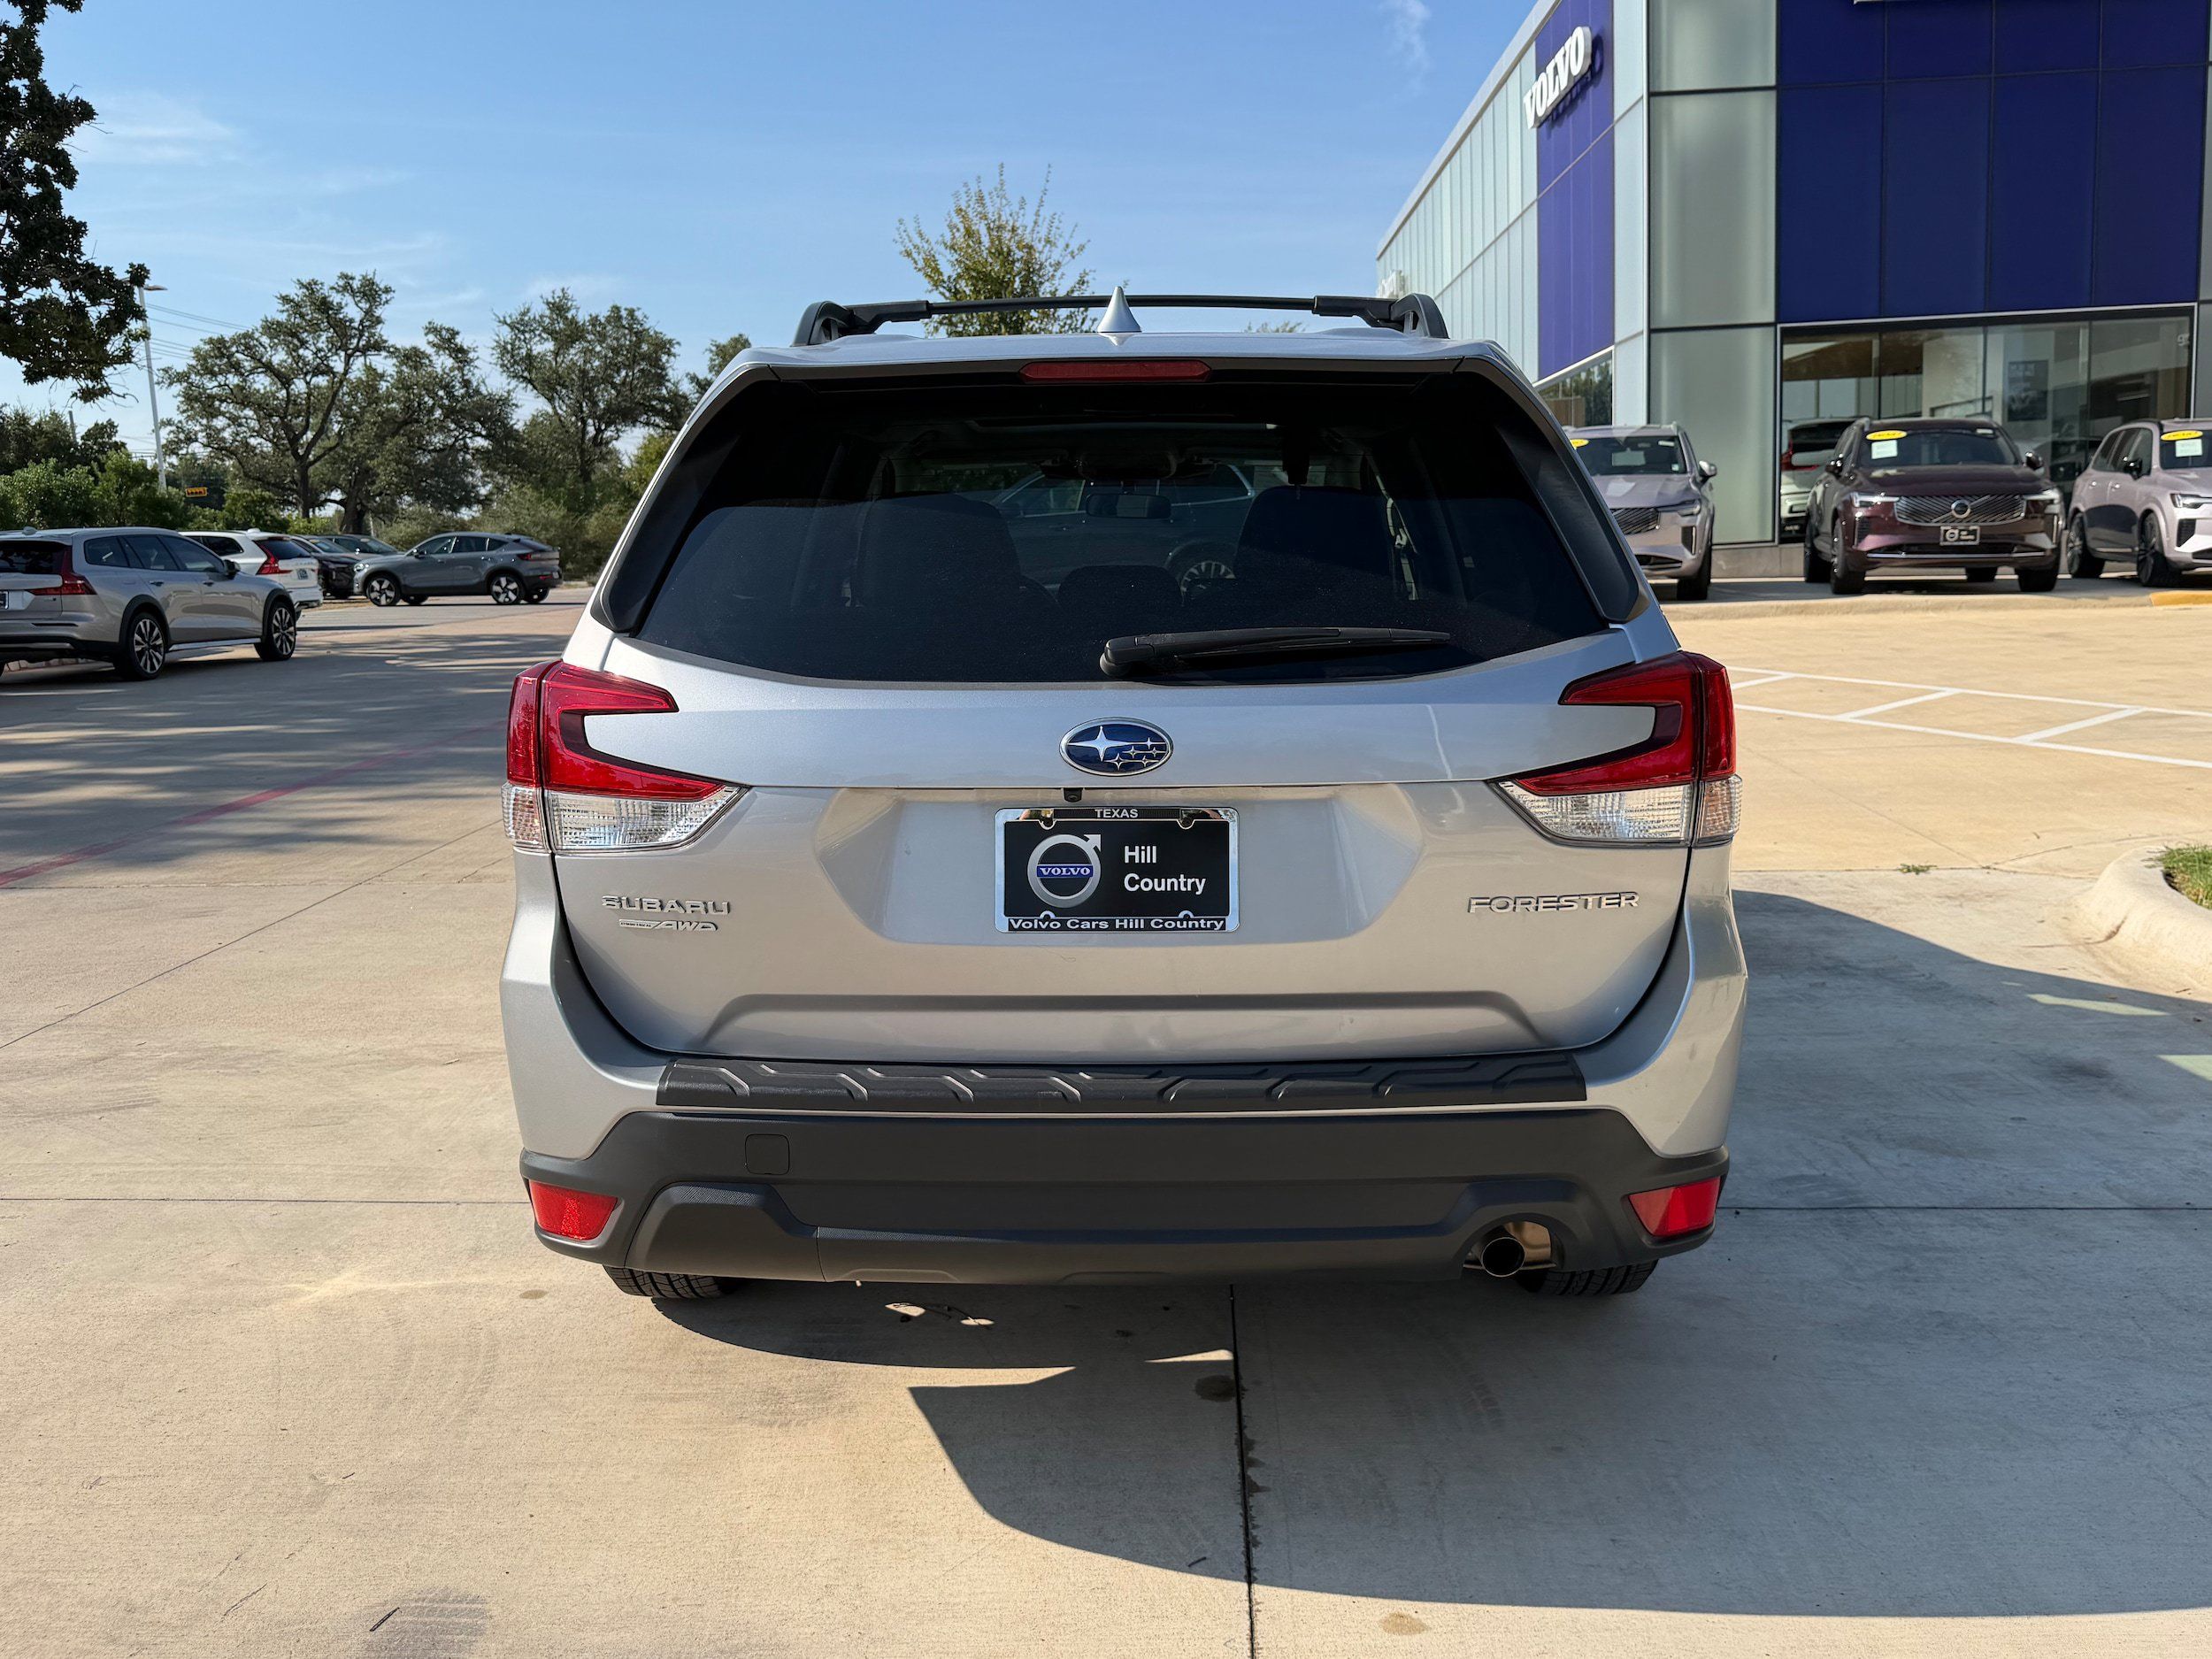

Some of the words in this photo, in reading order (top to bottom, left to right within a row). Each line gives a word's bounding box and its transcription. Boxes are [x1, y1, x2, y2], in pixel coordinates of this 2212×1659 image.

[1524, 27, 1591, 129] VOLVO
[1094, 809, 1139, 818] TEXAS
[1124, 846, 1156, 864] Hill
[1040, 866, 1091, 876] VOLVO
[1124, 873, 1206, 895] Country
[602, 895, 730, 915] SUBARU
[1468, 891, 1640, 913] FORESTER
[653, 920, 718, 931] AWD
[1009, 918, 1061, 929] Volvo
[1066, 918, 1110, 929] Cars
[1115, 918, 1145, 929] Hill
[1150, 918, 1225, 930] Country
